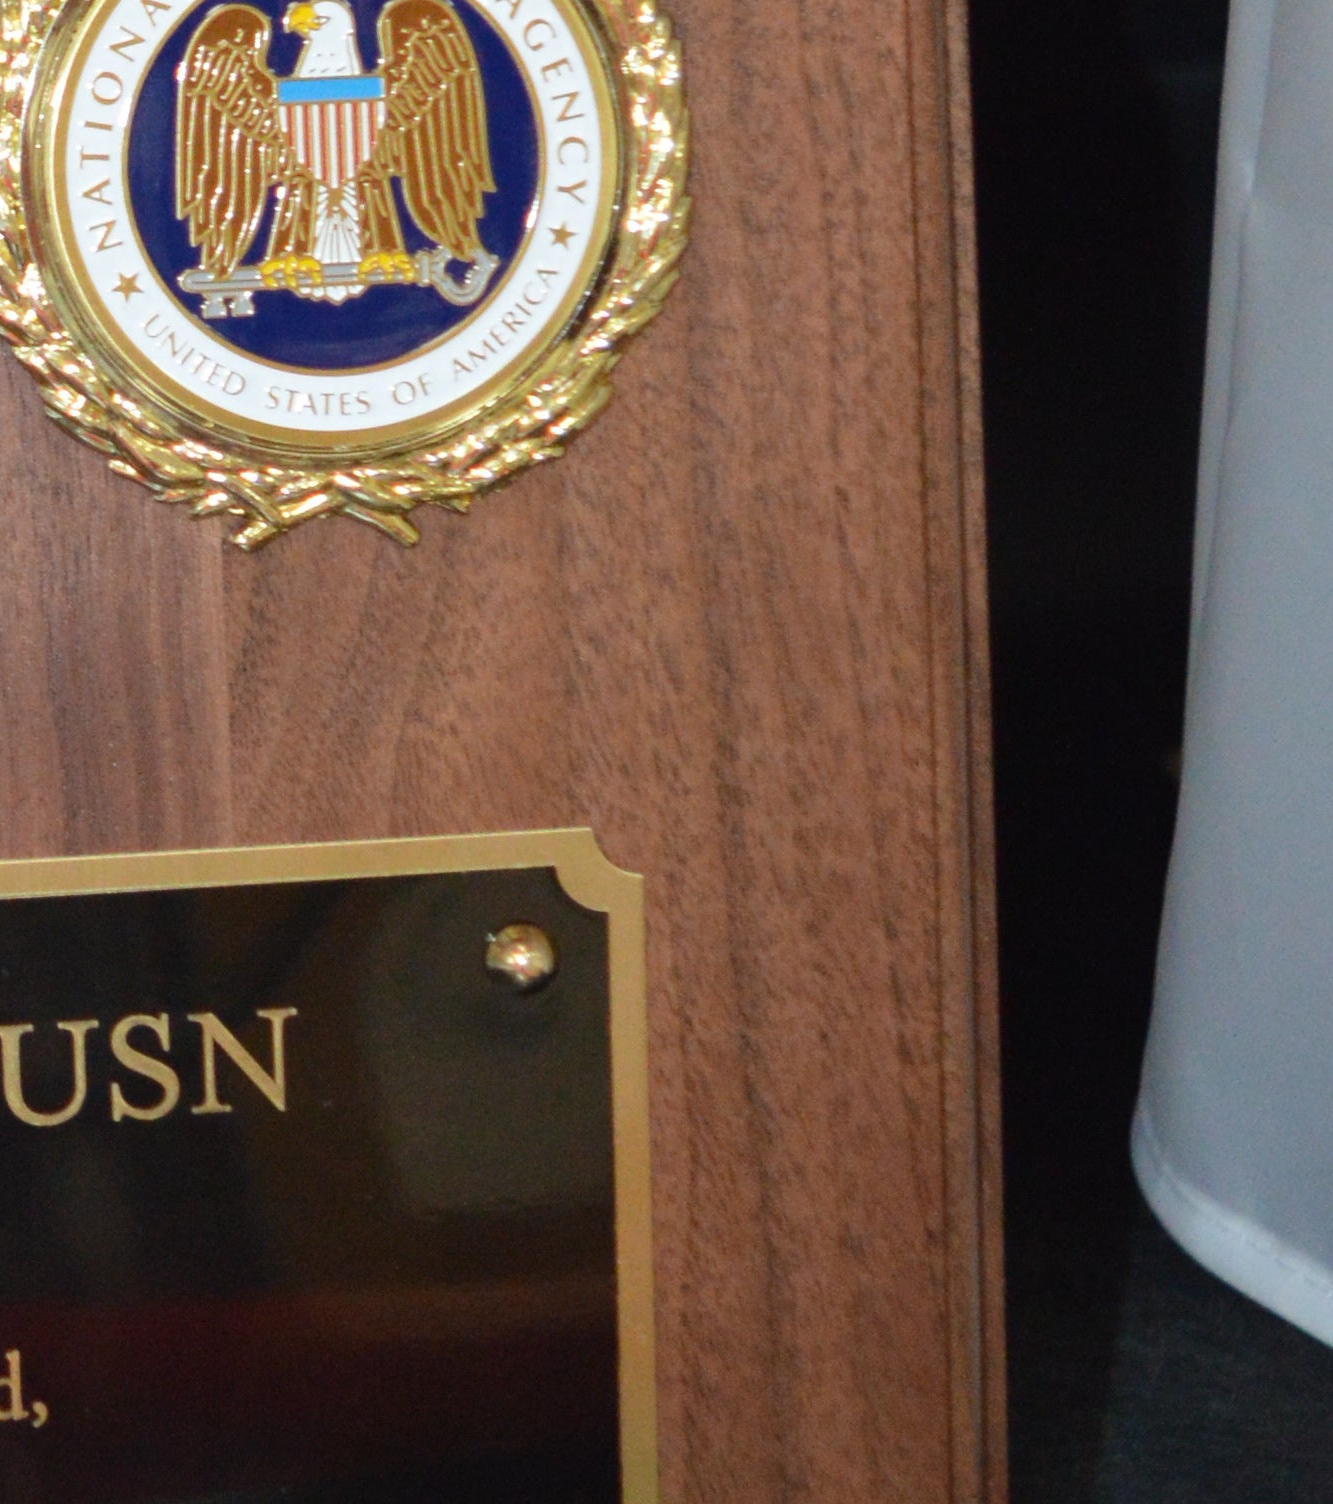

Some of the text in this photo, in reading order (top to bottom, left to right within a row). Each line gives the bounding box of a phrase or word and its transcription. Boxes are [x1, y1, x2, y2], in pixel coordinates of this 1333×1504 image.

[144, 265, 561, 415] UNITED STATES OF AMERICA
